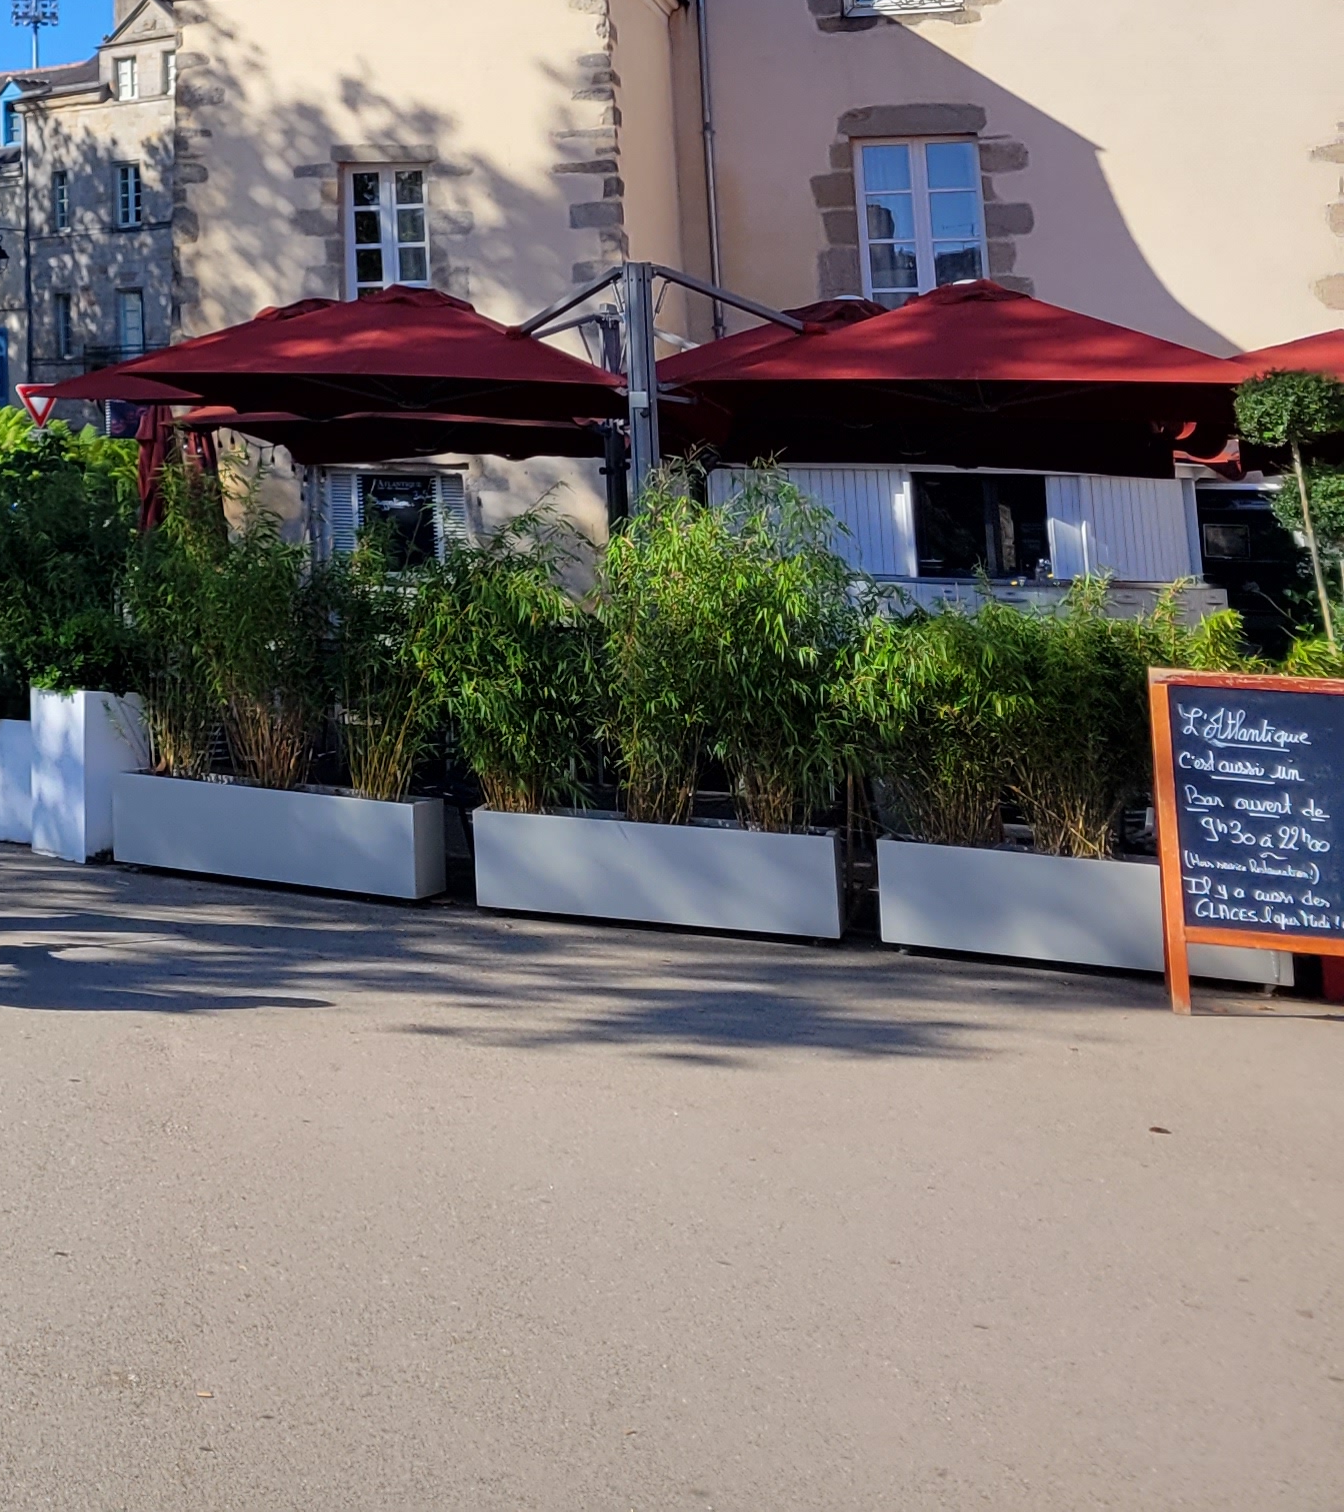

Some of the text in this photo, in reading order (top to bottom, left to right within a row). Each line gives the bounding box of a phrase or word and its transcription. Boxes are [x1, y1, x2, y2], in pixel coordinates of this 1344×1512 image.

[1178, 703, 1312, 748] L'Atlantique
[1218, 759, 1265, 777] aussi
[1270, 762, 1306, 782] un
[1184, 784, 1331, 819] Bar ouvert de
[1200, 816, 1257, 845] 9h30
[1278, 825, 1331, 853] 22h00
[1183, 875, 1212, 896] Il
[1214, 883, 1229, 900] y
[1233, 887, 1246, 899] a
[1301, 890, 1331, 908] des
[1194, 898, 1259, 923] GLACES
